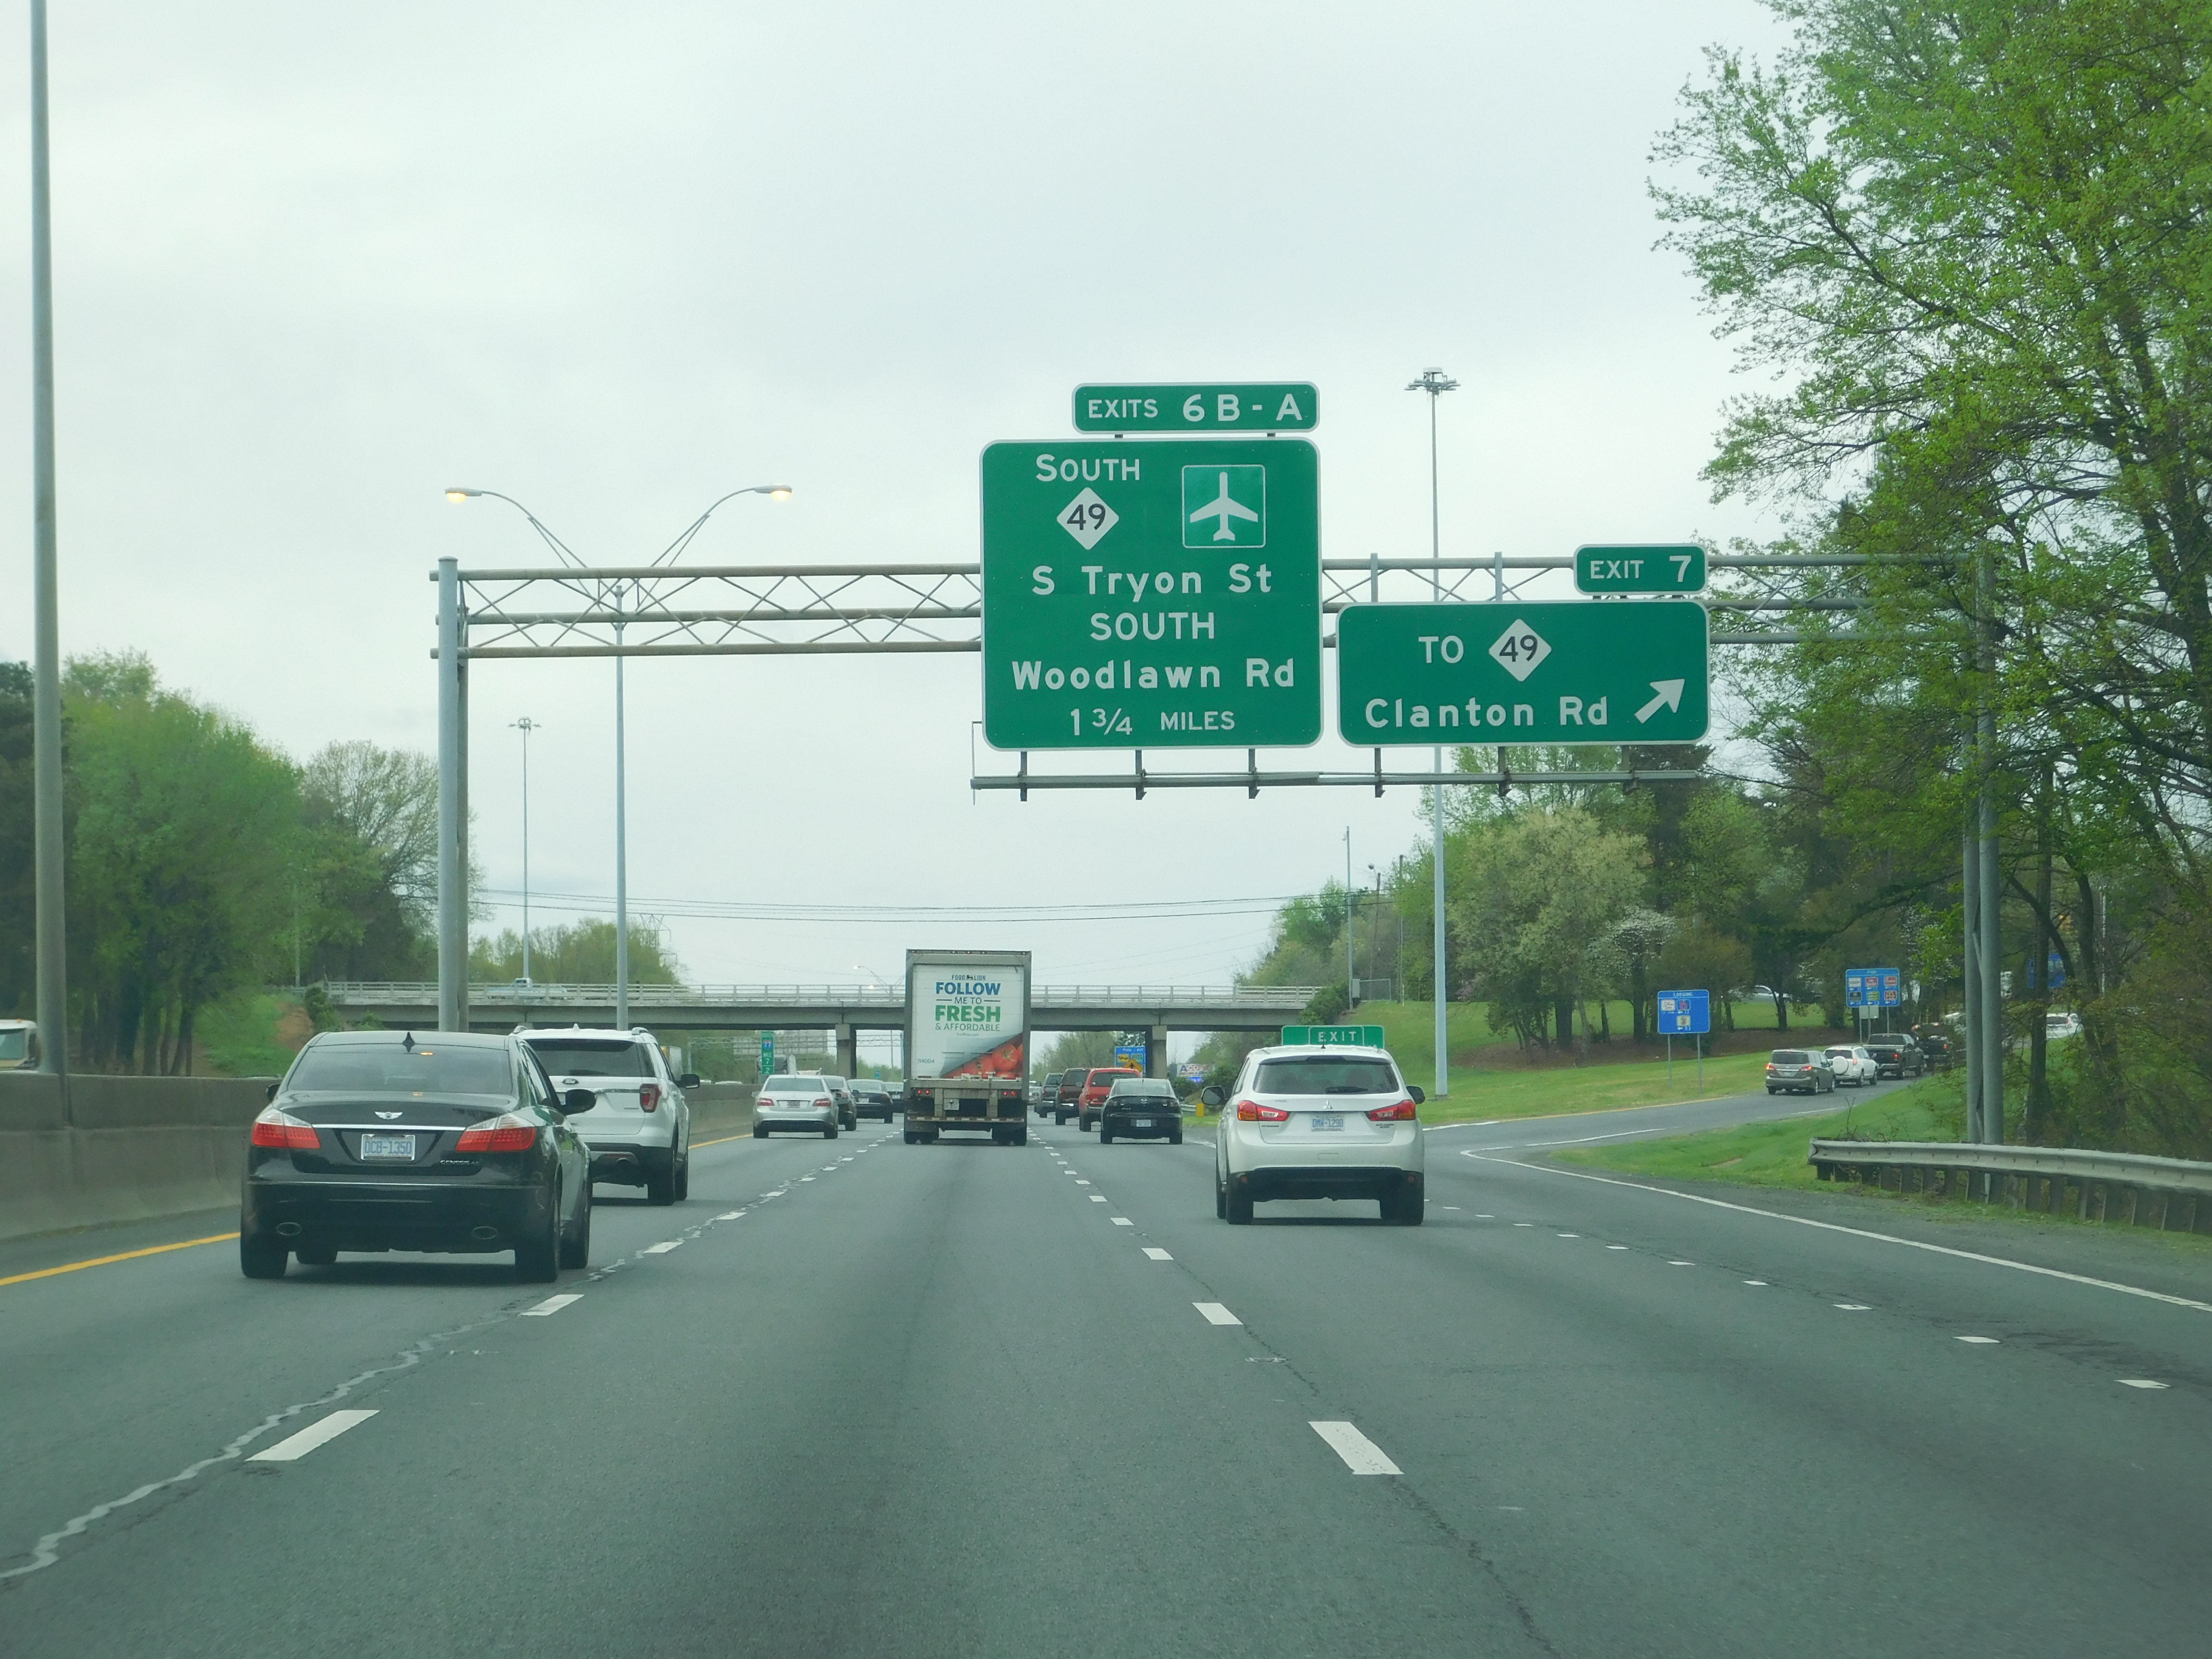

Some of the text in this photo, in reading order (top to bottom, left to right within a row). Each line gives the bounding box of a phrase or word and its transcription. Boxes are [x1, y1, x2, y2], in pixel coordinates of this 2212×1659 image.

[1088, 398, 1158, 418] EXITS
[1036, 454, 1140, 482] SOUTH
[1067, 503, 1106, 530] 49
[1590, 555, 1692, 582] EXIT 7
[1032, 563, 1272, 602] S Tryon St
[1090, 612, 1214, 641] SOUTH
[1418, 635, 1539, 663] TO 49
[1012, 658, 1294, 690] Woodlawn Rd
[1070, 709, 1080, 736] 1
[1161, 710, 1235, 730] MILES
[1365, 696, 1608, 728] Clanton Rd
[936, 982, 1001, 996] FOLLOW
[935, 1005, 1001, 1022] FRESH
[943, 1023, 1000, 1032] AFFORDABLE
[1318, 1031, 1357, 1042] EXIT
